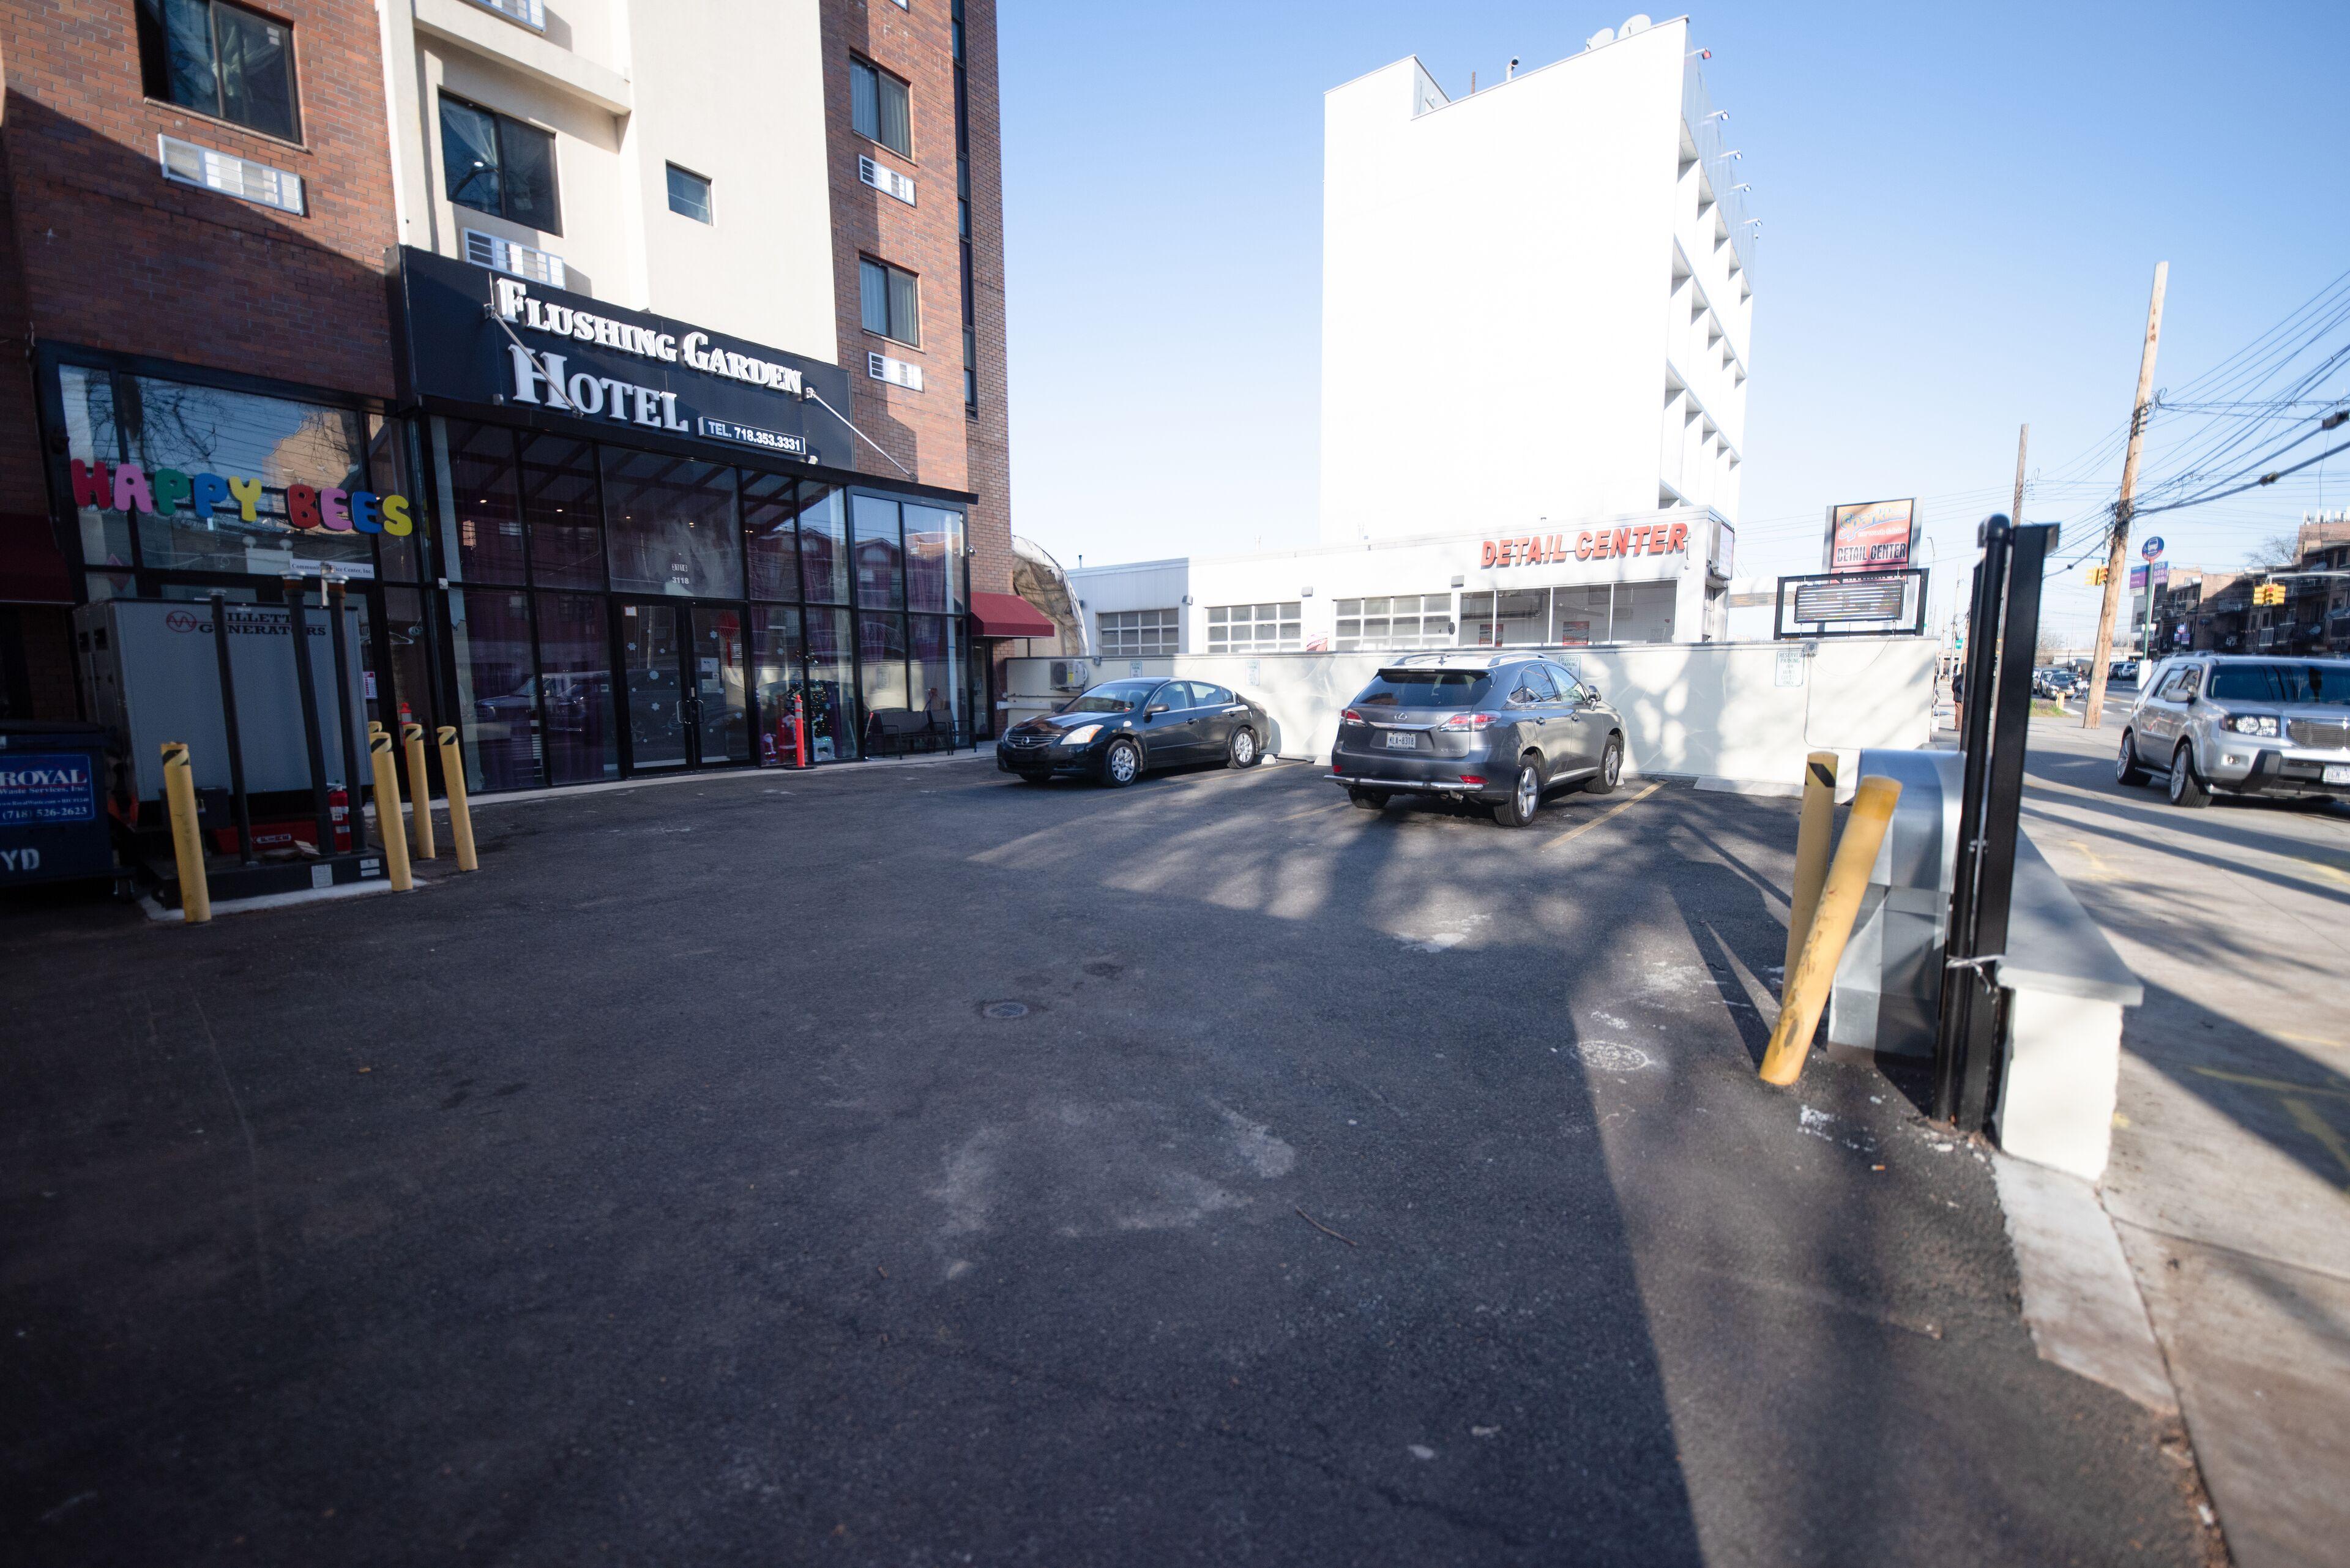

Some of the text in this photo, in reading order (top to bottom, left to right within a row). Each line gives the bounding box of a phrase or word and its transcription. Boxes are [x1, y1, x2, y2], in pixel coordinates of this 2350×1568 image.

[496, 277, 803, 394] FLUSHING GARDEN
[508, 343, 689, 433] HOTEL
[707, 420, 801, 452] TEL. 718.353.3331
[71, 458, 413, 537] HAPPY BEES
[1480, 534, 1567, 570] DETAIL
[1575, 522, 1688, 560] CENTER
[1837, 542, 1907, 562] DETAIL CENTER
[199, 624, 326, 636] GNERATRS
[211, 612, 291, 624] ILLETT
[0, 769, 88, 786] ROYAL
[2, 807, 88, 819] (718) 526-2623
